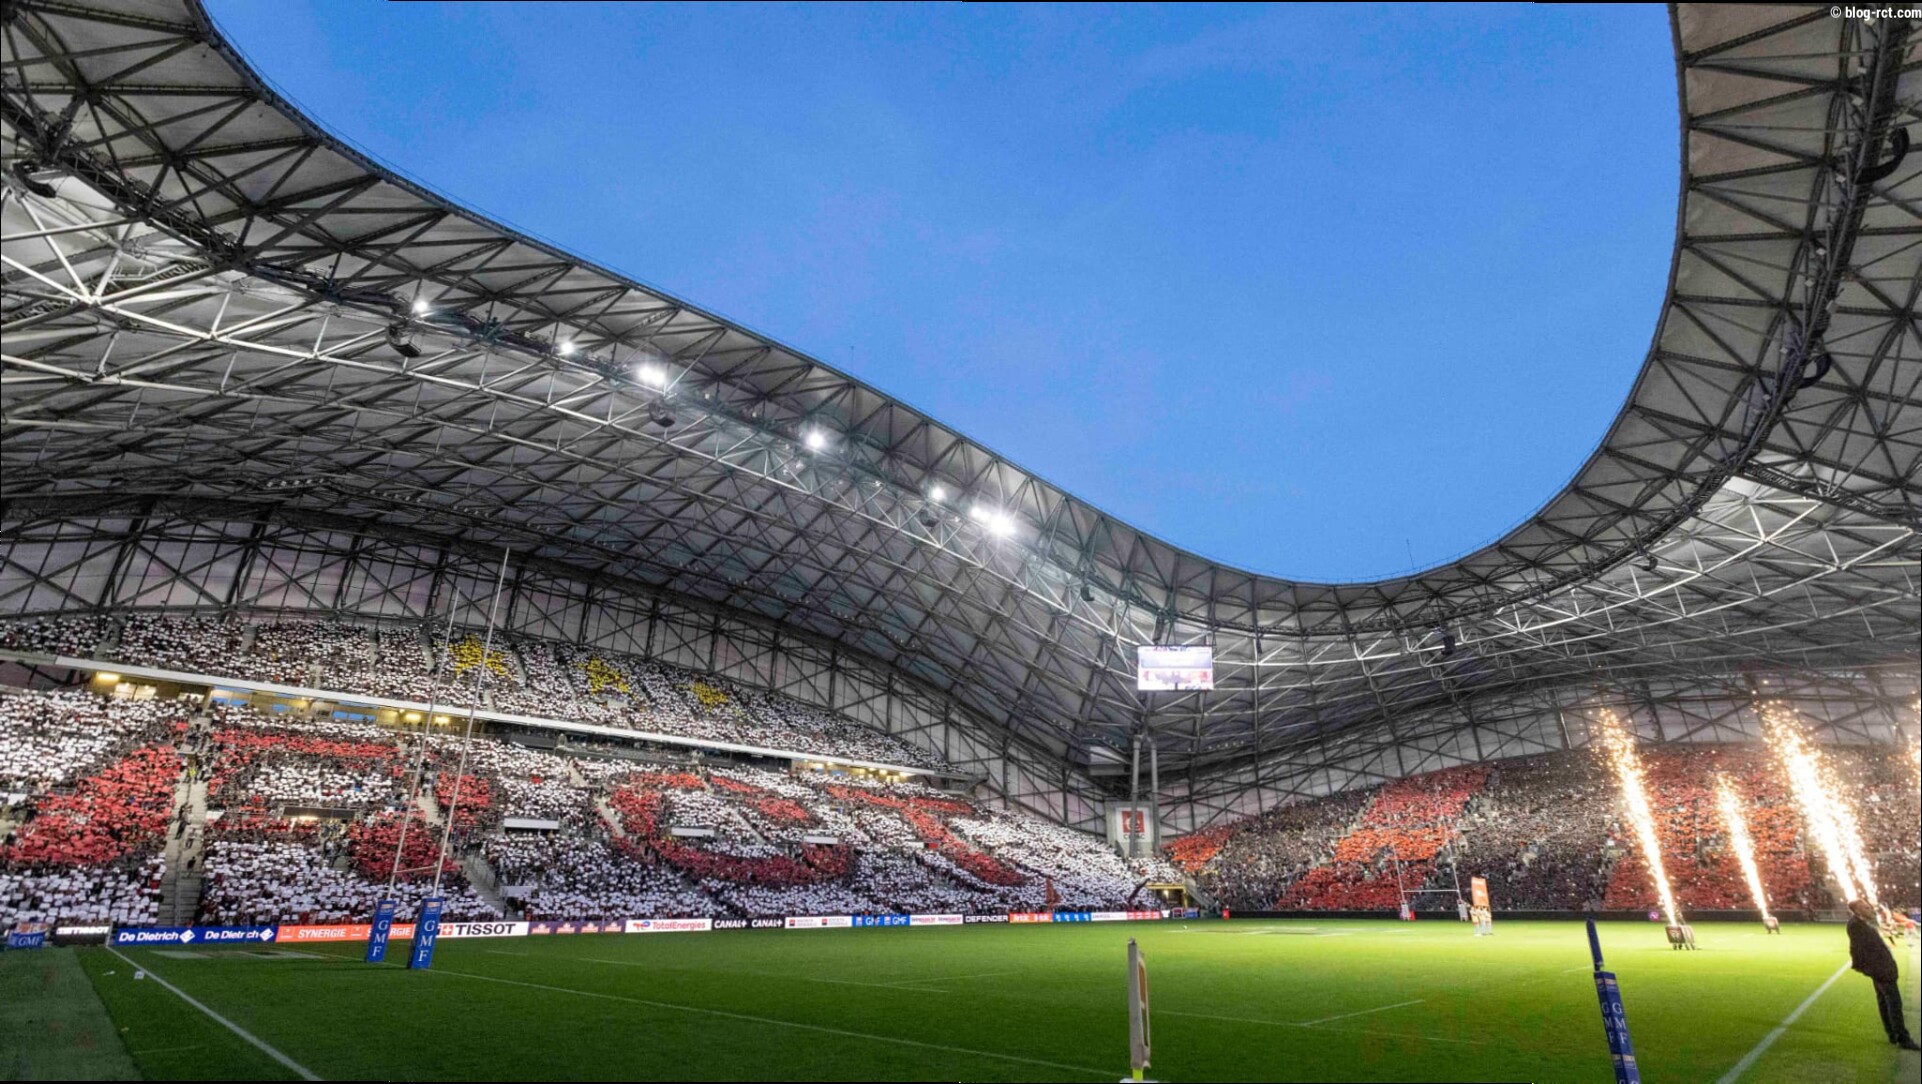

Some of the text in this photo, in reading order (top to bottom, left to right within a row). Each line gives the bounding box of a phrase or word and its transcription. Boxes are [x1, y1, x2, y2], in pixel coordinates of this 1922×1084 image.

[714, 918, 748, 929] CANAL+
[751, 918, 783, 928] CANAL+
[965, 915, 1009, 923] DEFENDER
[456, 923, 516, 936] TISSOT
[652, 920, 706, 931] TotalEnergies
[119, 931, 178, 942] De Dietrich
[205, 930, 259, 940] De Dietrch
[298, 928, 346, 938] SYNERGIE
[372, 919, 389, 957] GMF
[418, 920, 436, 961] GMF
